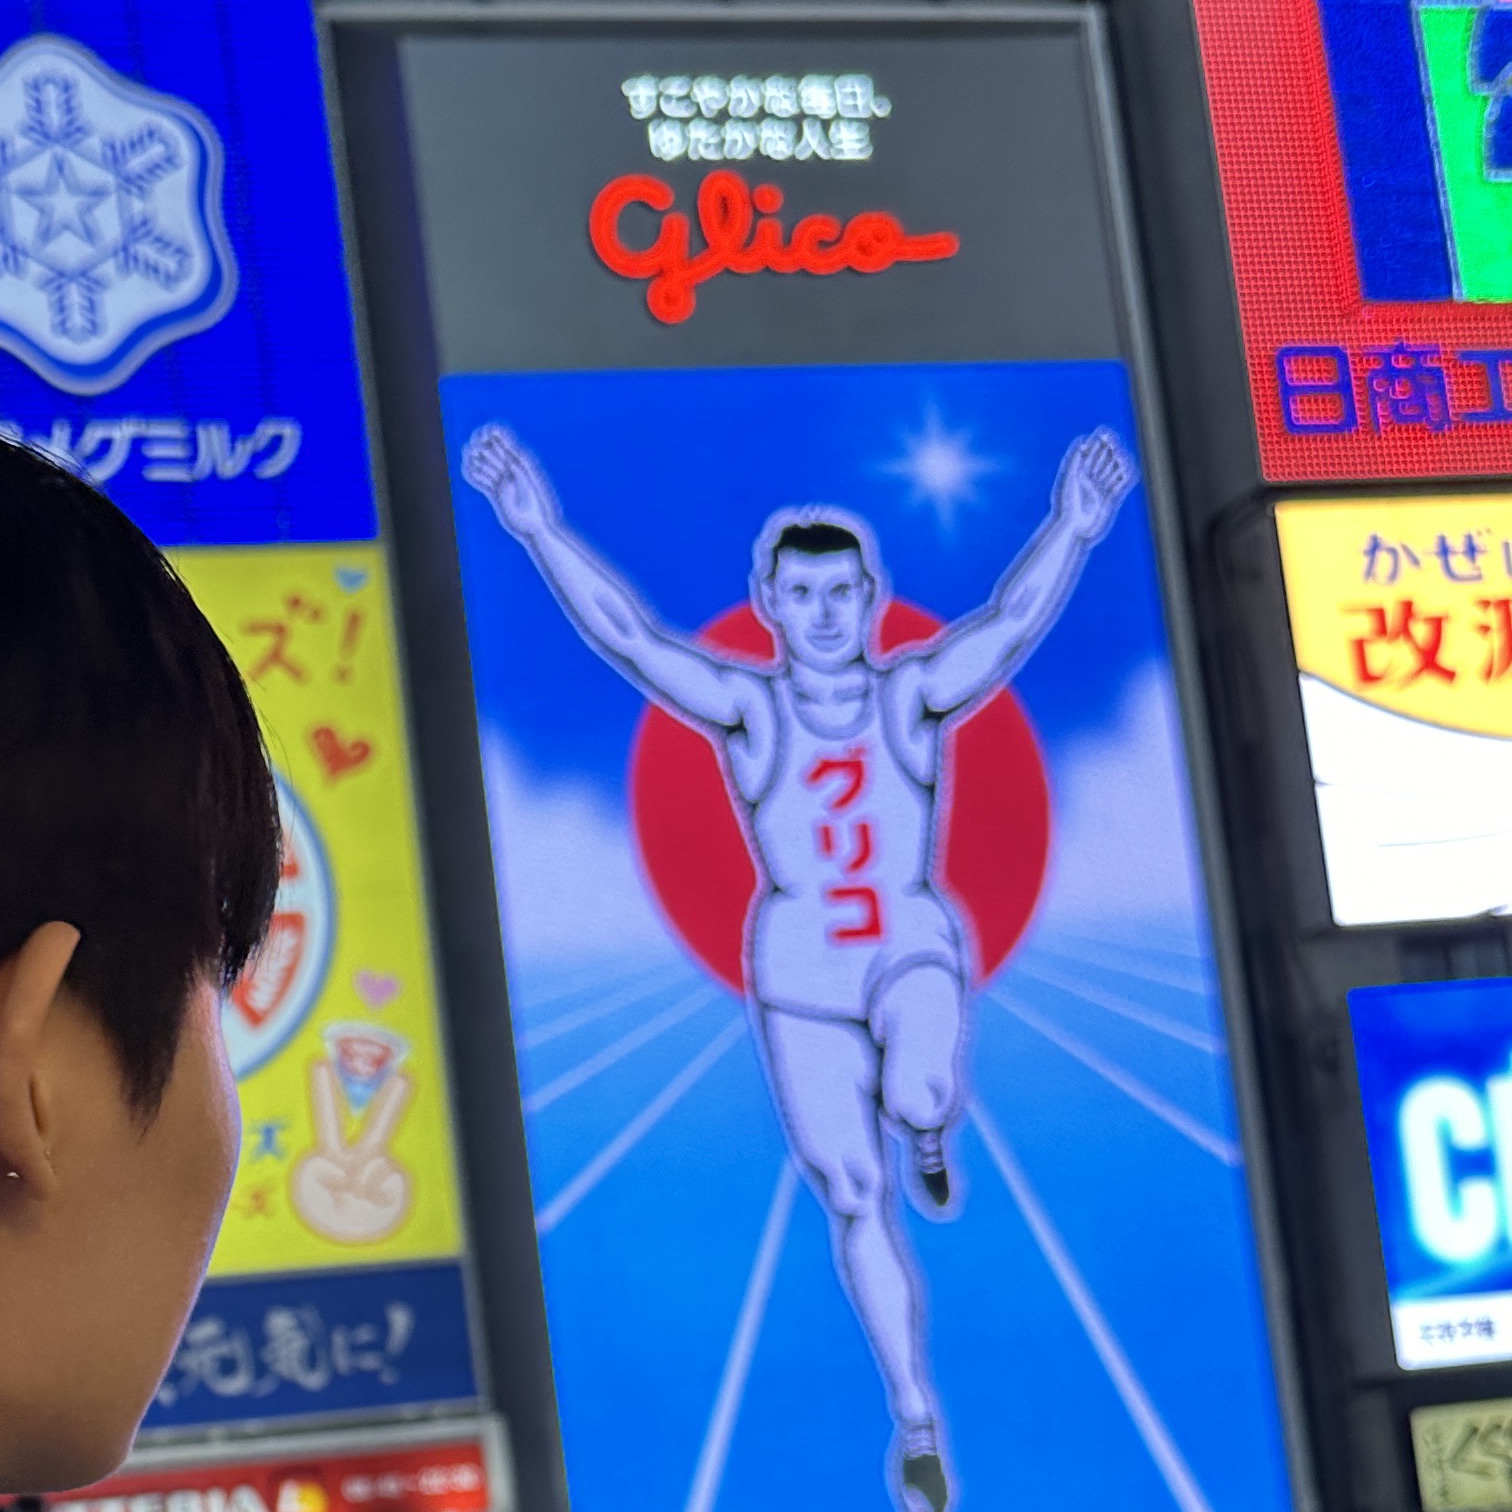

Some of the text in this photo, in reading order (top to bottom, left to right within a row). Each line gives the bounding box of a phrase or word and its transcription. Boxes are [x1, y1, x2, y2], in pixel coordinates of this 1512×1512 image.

[621, 74, 892, 120] すこやかな毎日。
[647, 117, 874, 161] ゆたかな人生
[589, 169, 960, 325] Glico
[1362, 527, 1512, 585] かぜ
[805, 744, 884, 942] グリコ
[1397, 1072, 1512, 1265] C
